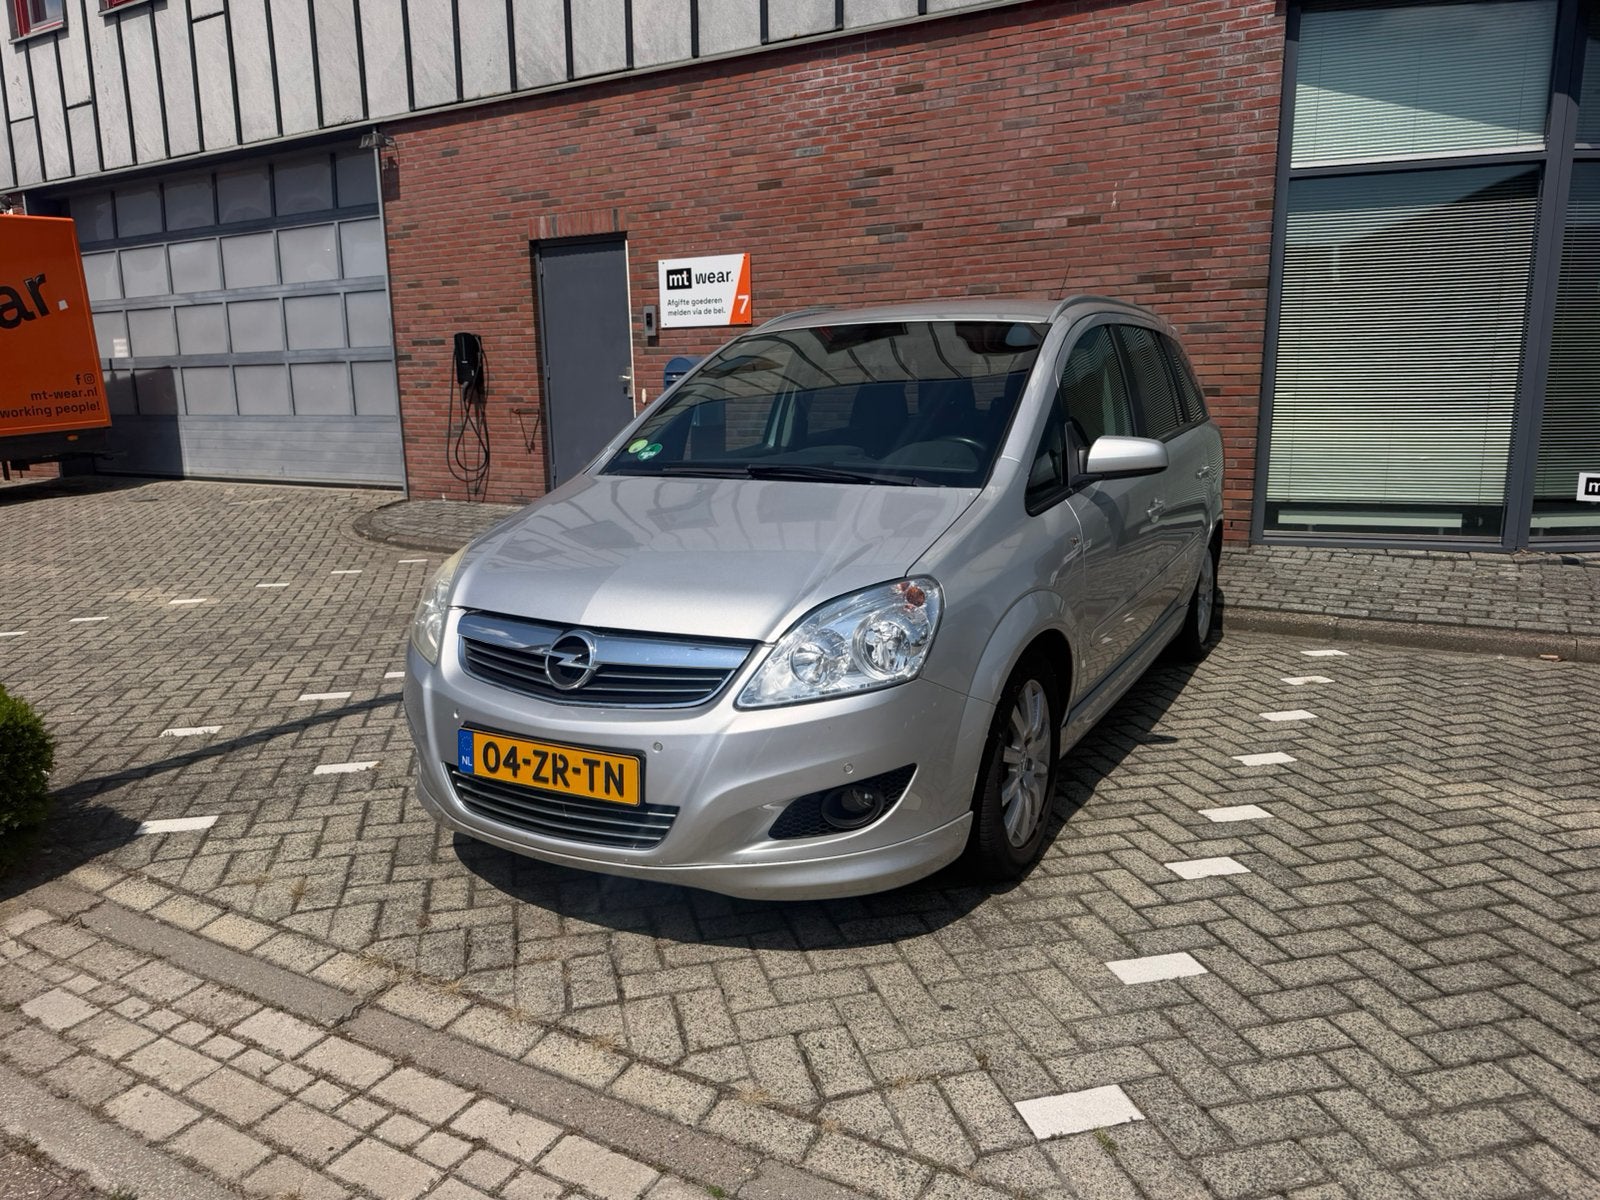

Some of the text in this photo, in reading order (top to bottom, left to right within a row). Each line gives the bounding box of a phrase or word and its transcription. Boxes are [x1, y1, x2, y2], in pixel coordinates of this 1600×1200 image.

[669, 271, 733, 287] mt wear.
[668, 297, 723, 308] Afgifte goederen
[737, 294, 749, 315] 7
[31, 387, 98, 401] mt-wear.nl
[0, 401, 101, 418] working people!
[461, 755, 472, 767] NL
[482, 741, 625, 798] 04-ZR-TN
